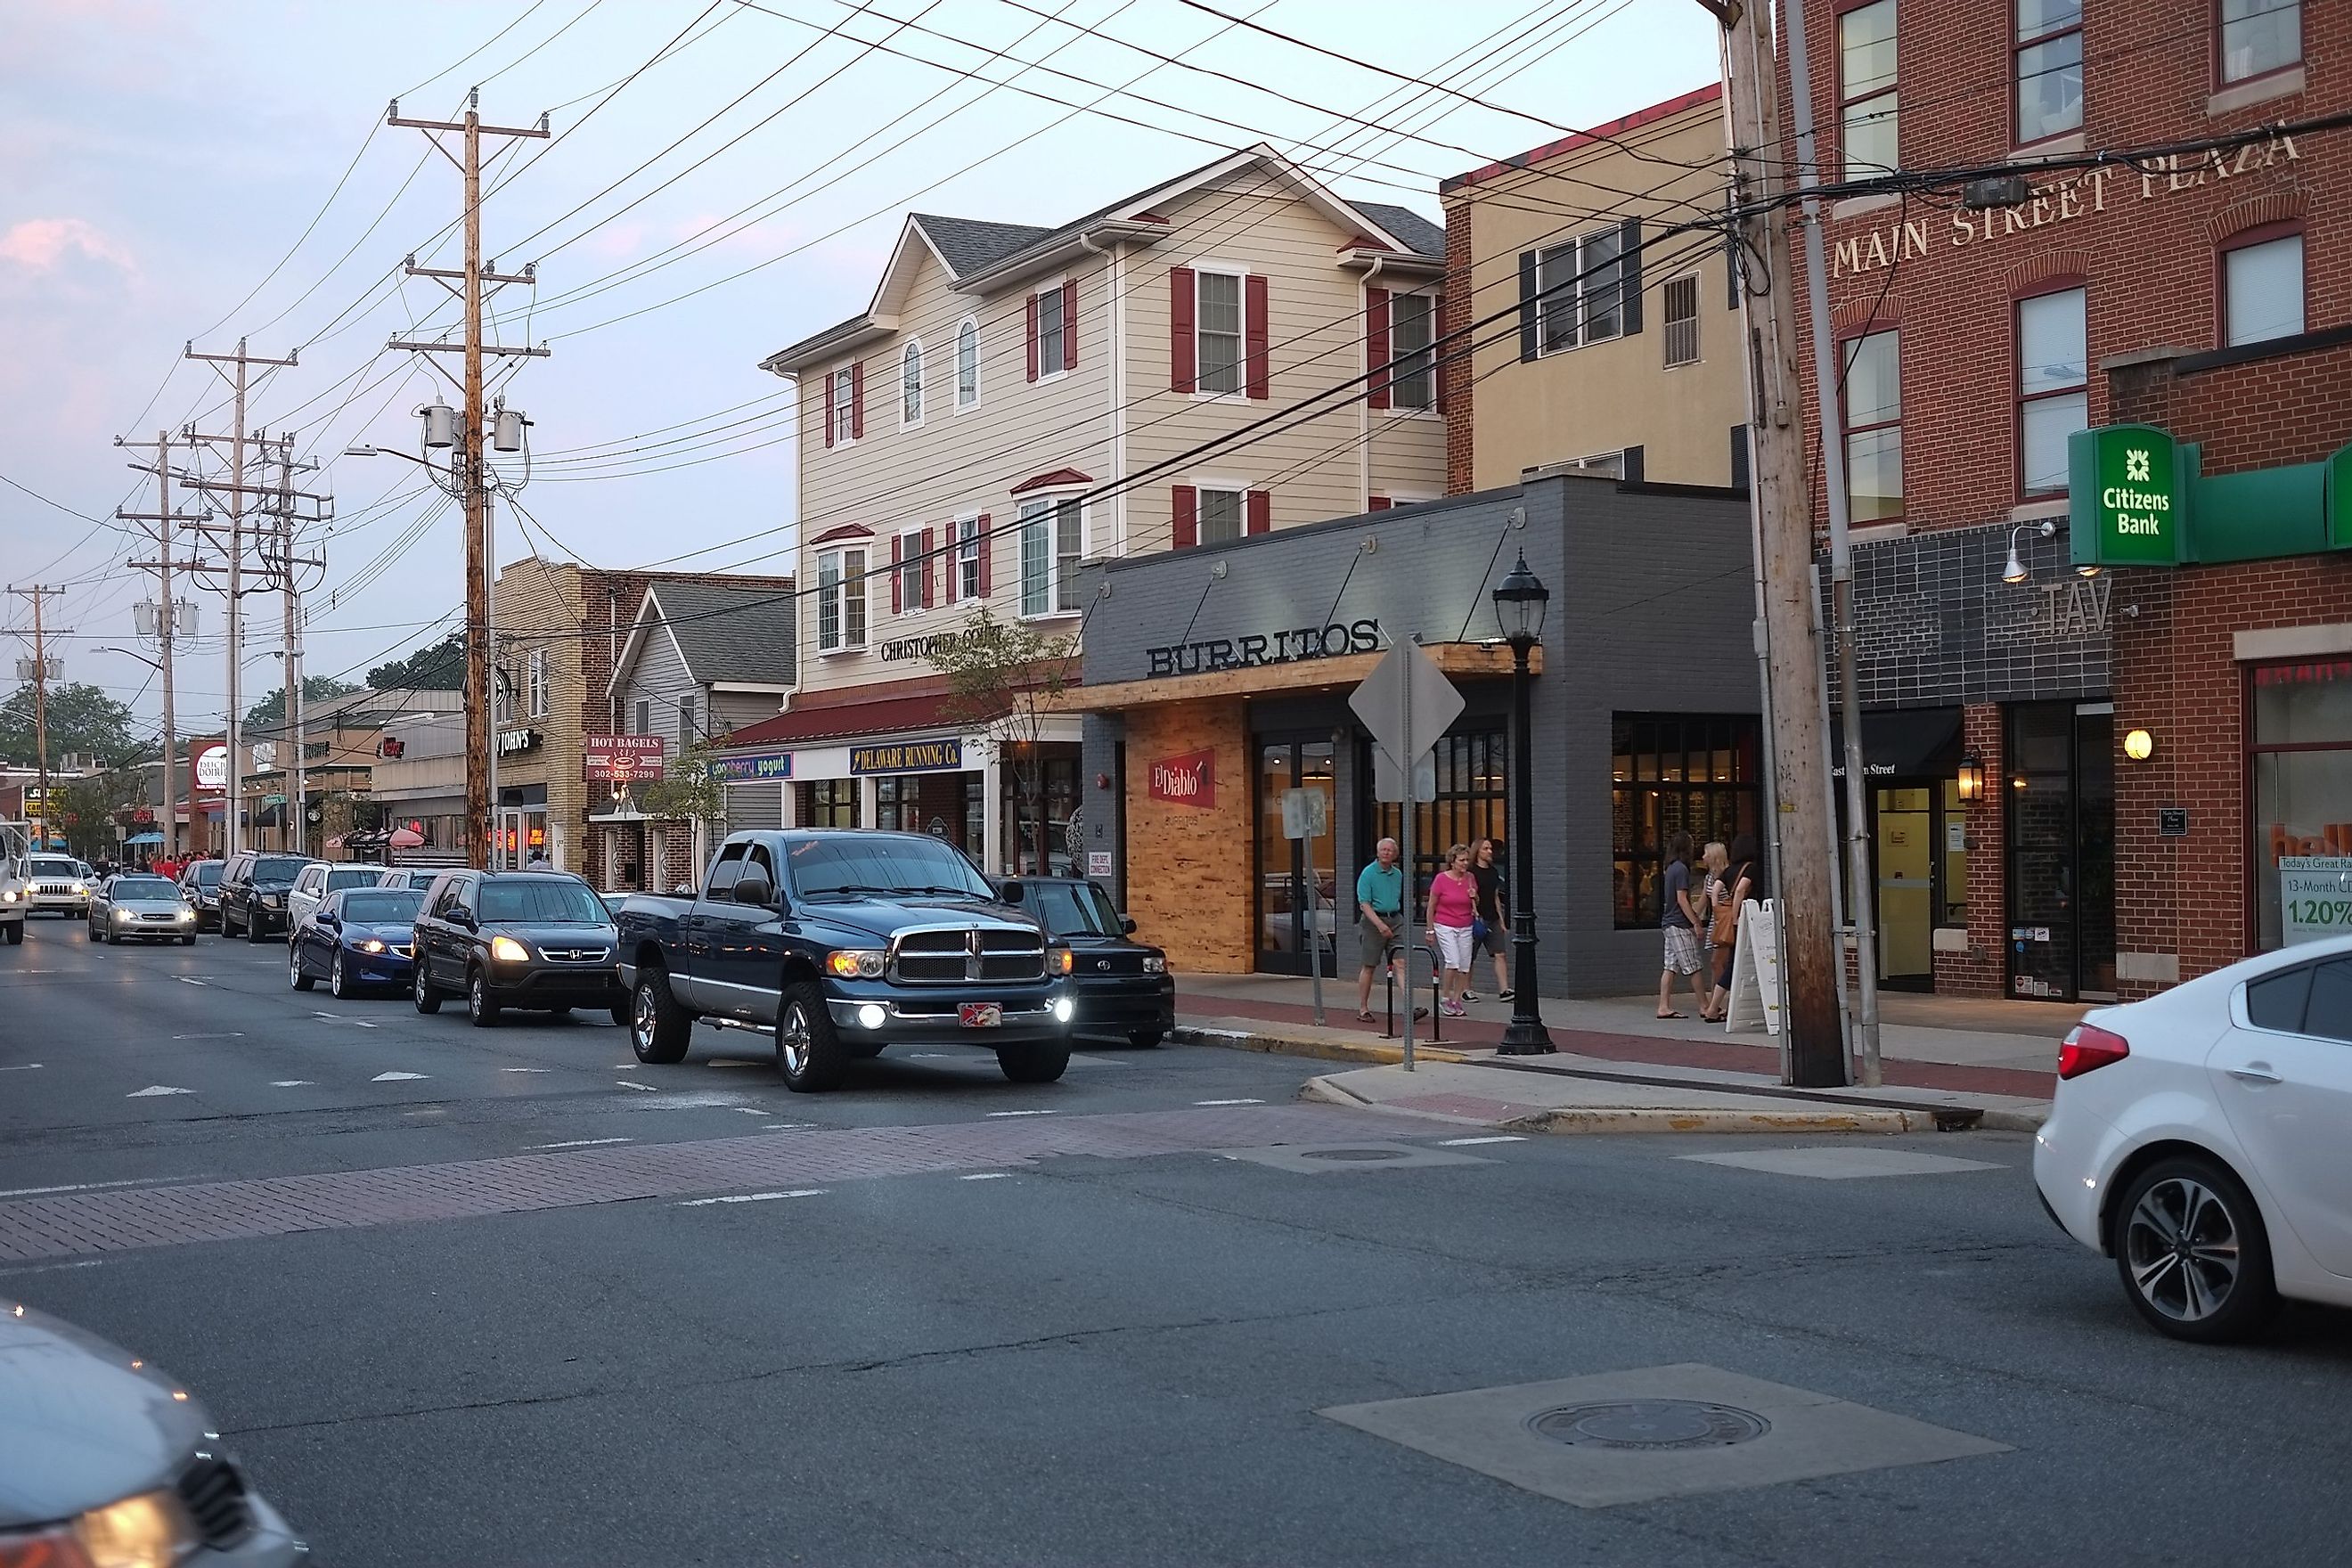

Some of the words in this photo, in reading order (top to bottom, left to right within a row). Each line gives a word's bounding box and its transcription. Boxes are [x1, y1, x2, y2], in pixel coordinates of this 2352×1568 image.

[1833, 217, 1929, 279] MAIN
[1952, 167, 2113, 247] STREET
[2141, 118, 2301, 199] PLAZA
[2103, 487, 2169, 511] Citizens
[2118, 513, 2160, 535] Bank
[2041, 578, 2112, 634] TAV
[1146, 618, 1378, 680] BURRITOS
[501, 729, 529, 756] JOHN'S
[591, 738, 614, 747] HOT
[617, 738, 659, 748] BAGELS
[757, 755, 784, 776] yogurt
[861, 747, 902, 771] DELAWARE
[905, 745, 943, 766] RUNNING
[1870, 764, 1896, 775] Street
[1155, 764, 1163, 788] El
[1164, 767, 1197, 797] Diablo
[2282, 858, 2310, 870] Today's
[2313, 858, 2339, 869] Great
[2288, 879, 2335, 893] 13-Month
[2289, 900, 2352, 925] 1.20%
